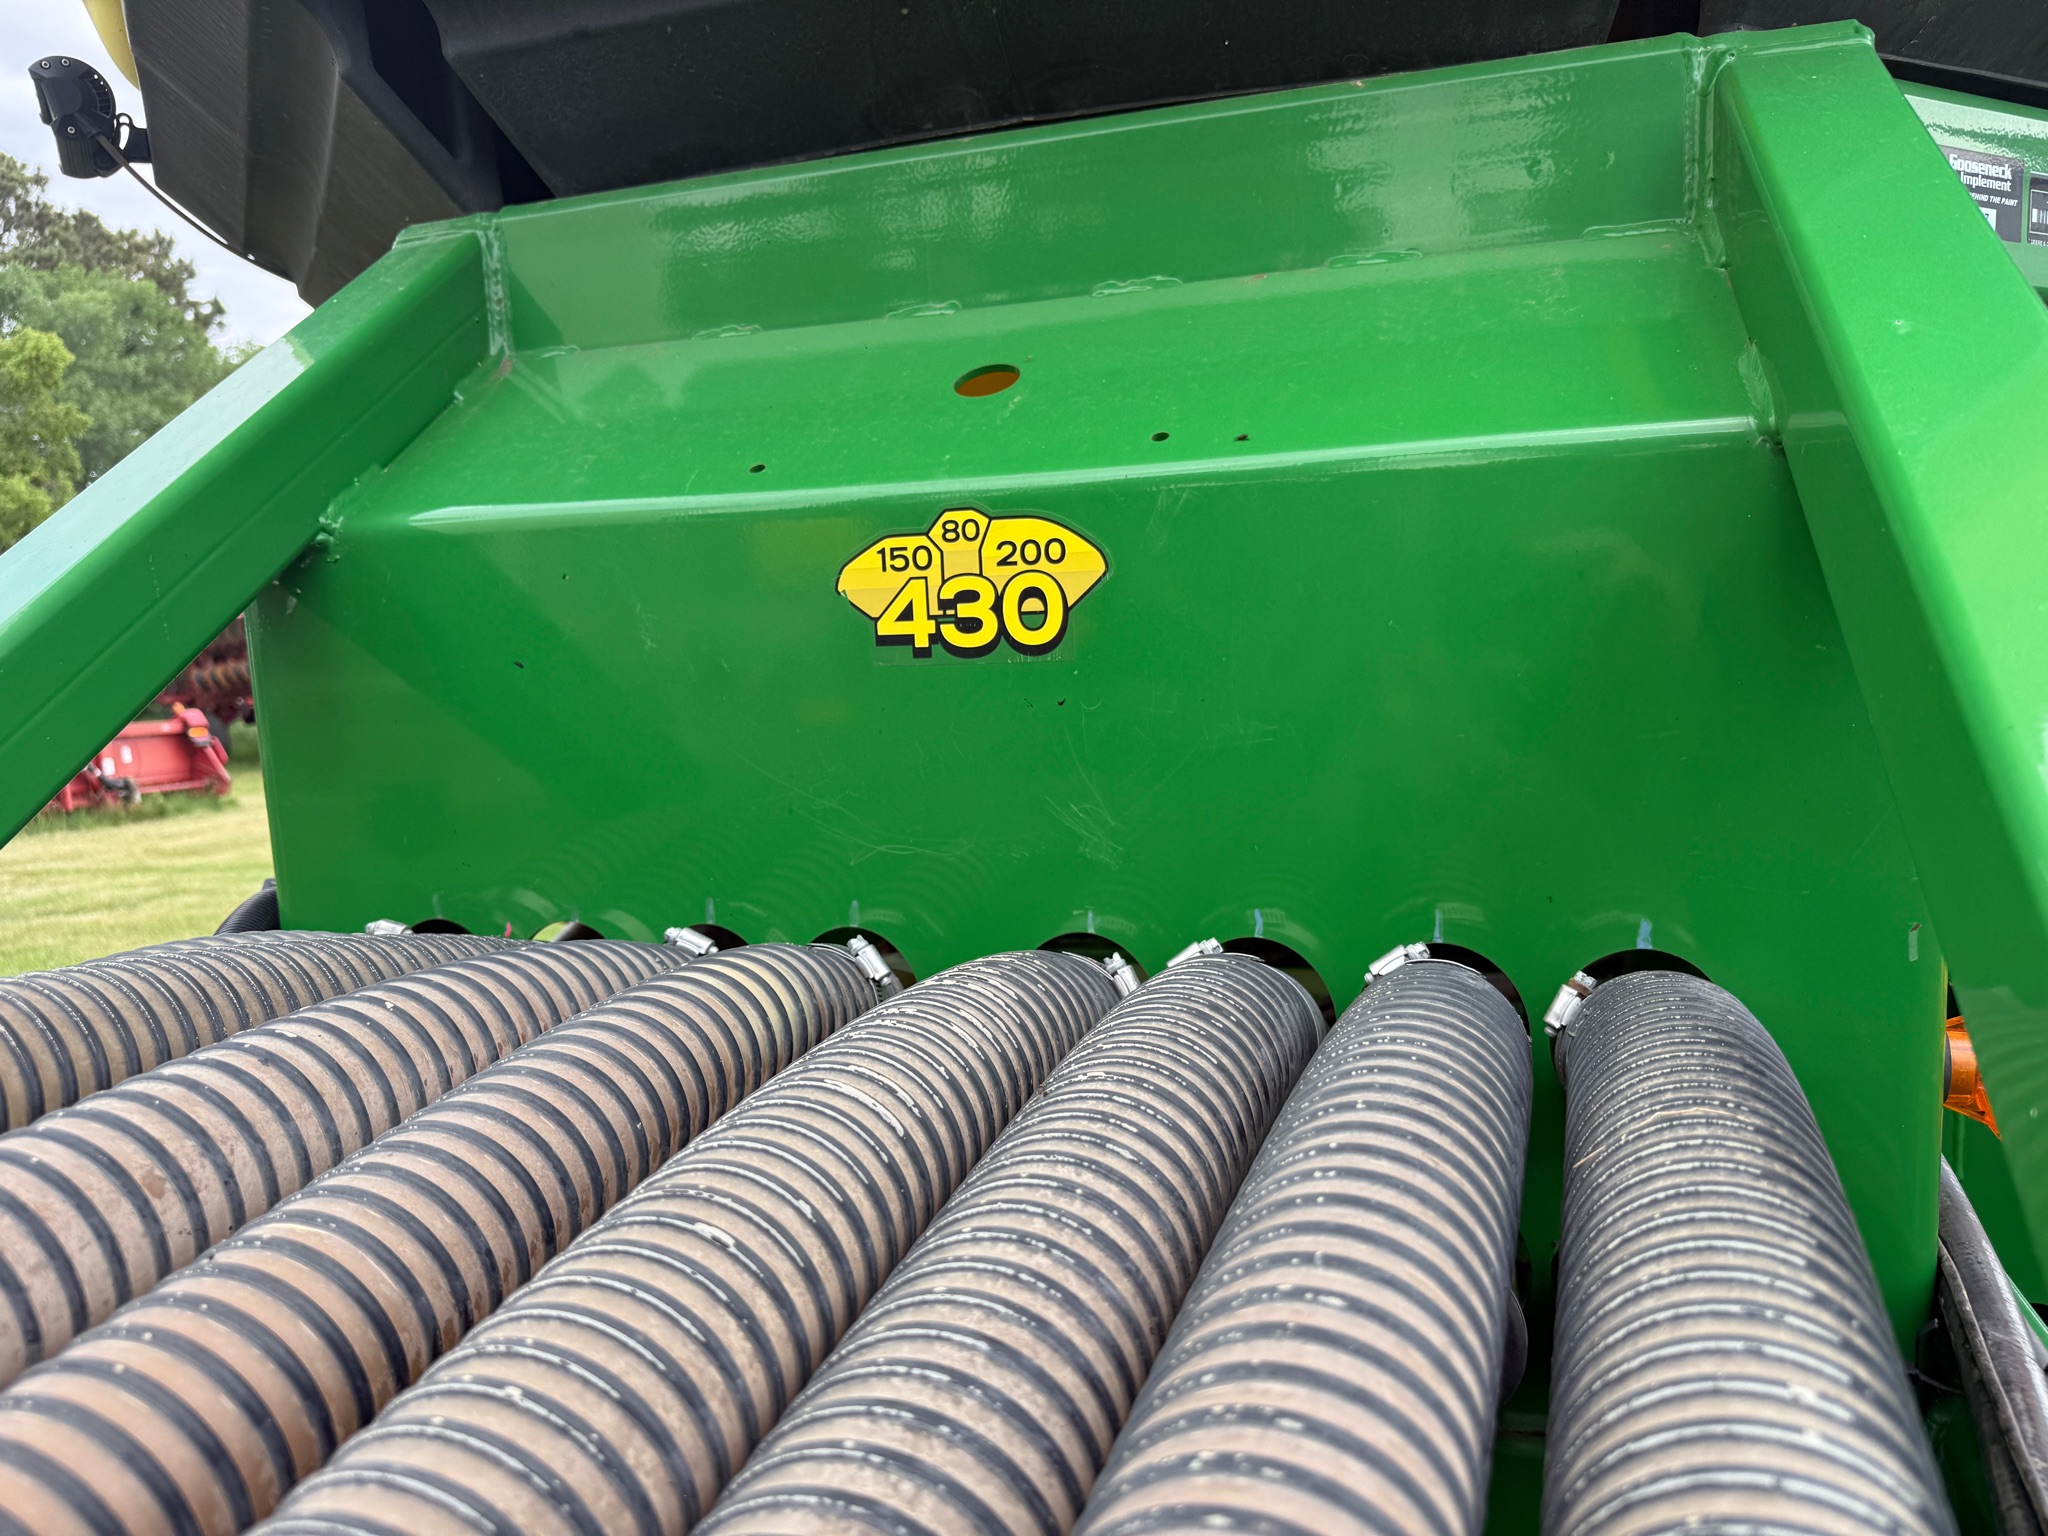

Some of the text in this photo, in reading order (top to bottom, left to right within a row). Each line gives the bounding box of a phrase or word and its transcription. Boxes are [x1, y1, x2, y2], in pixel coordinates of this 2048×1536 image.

[1949, 153, 2012, 180] Gooseneck
[1960, 171, 2012, 192] Implement
[1990, 195, 2001, 204] THE
[2001, 197, 2018, 207] PAINT
[941, 518, 981, 543] 80
[876, 545, 933, 573] 150
[996, 537, 1066, 566] 200
[875, 570, 1069, 659] 430
